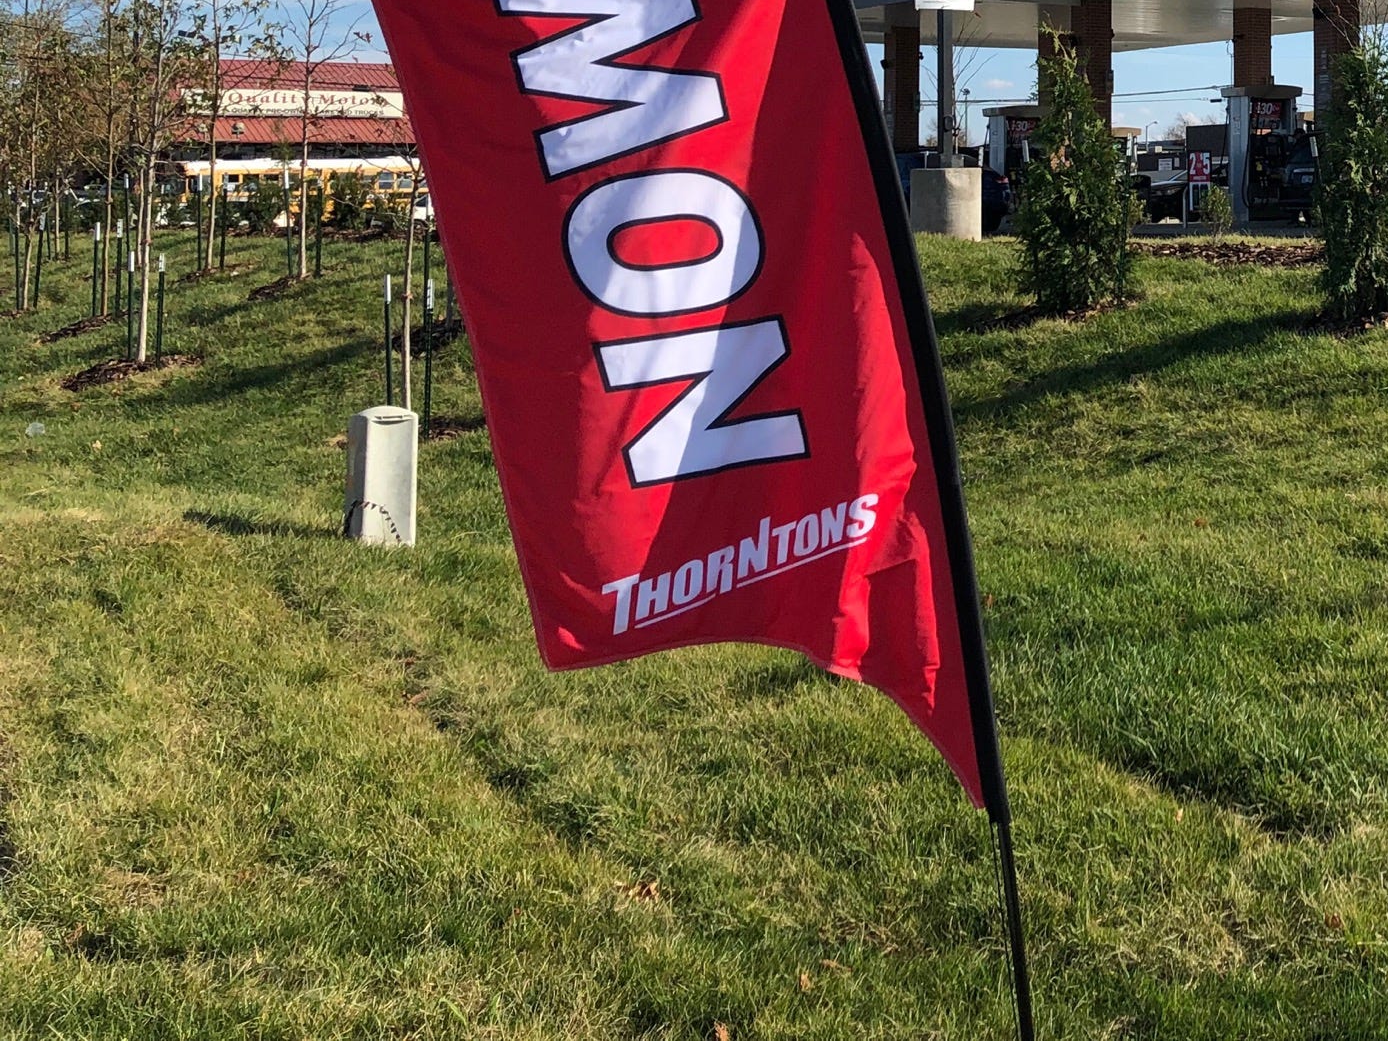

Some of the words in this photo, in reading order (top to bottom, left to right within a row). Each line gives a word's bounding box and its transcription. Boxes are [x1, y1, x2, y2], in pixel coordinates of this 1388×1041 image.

[228, 91, 313, 105] Qualit
[1189, 152, 1197, 175] 2
[602, 493, 878, 635] THORNTONS
